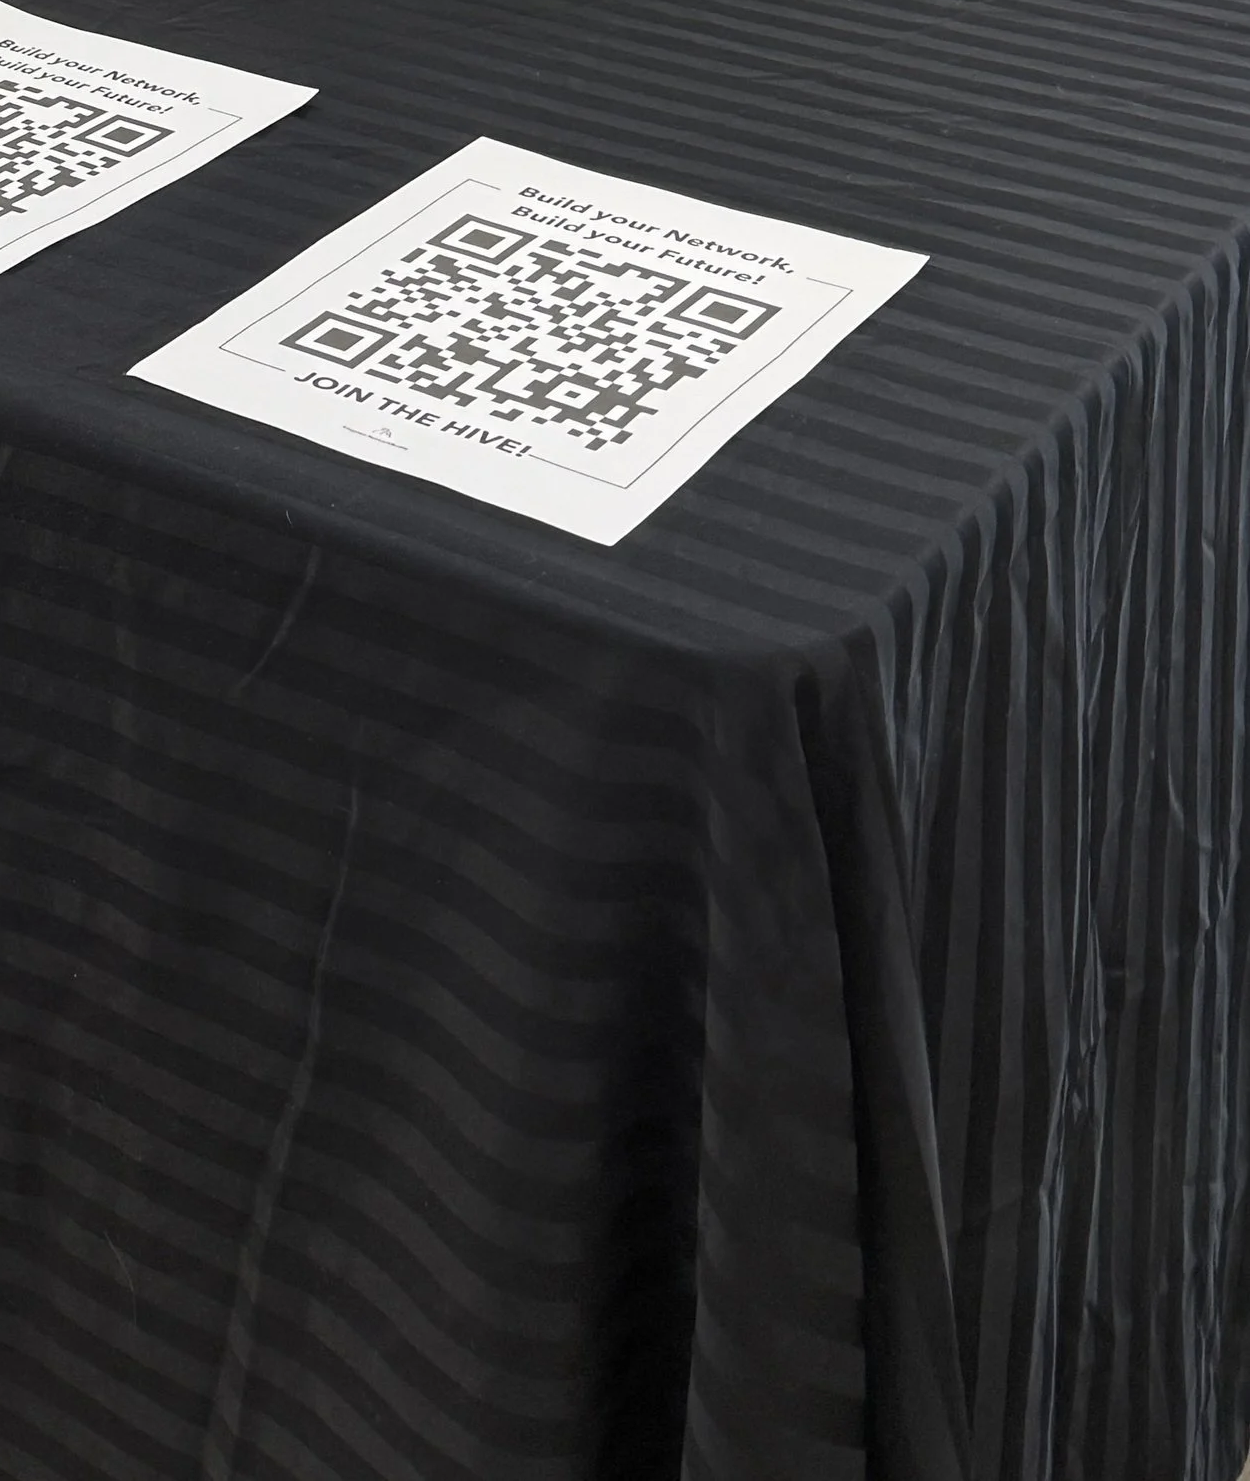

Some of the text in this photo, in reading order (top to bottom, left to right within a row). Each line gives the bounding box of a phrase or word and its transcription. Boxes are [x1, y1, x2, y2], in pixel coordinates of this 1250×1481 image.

[34, 70, 91, 90] your
[90, 85, 173, 116] Future!
[47, 55, 104, 75] your
[103, 70, 202, 107] Network,
[511, 205, 766, 286] Build your Future!
[518, 186, 794, 275] Build your Network,
[293, 371, 375, 403] JOIN
[378, 396, 441, 427] THE
[440, 420, 533, 457] HIVE!
